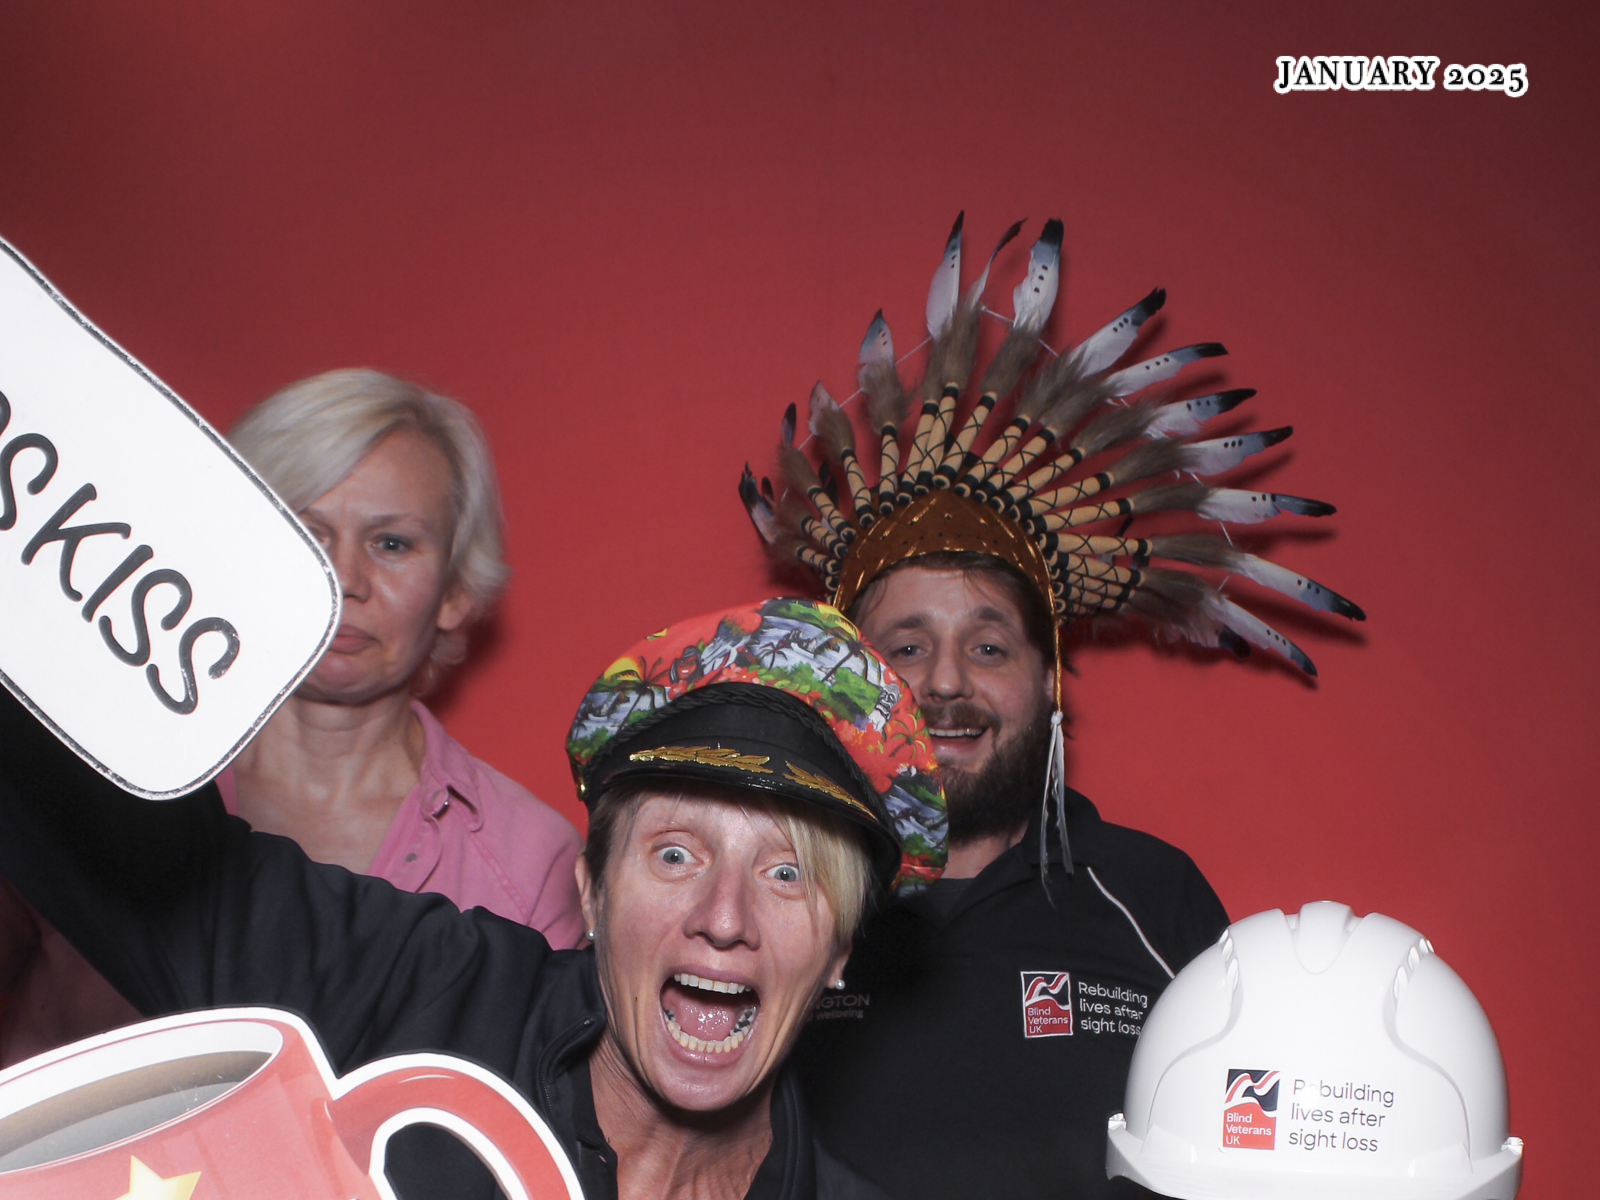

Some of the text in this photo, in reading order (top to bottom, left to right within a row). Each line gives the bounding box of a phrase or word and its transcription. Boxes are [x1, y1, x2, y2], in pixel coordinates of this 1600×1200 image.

[1078, 981, 1148, 1009] Rebuilding
[1027, 1007, 1051, 1016] Blind
[1079, 998, 1144, 1020] lives after
[1027, 1016, 1069, 1025] Veterans
[1080, 1017, 1142, 1036] sight loss
[1029, 1025, 1043, 1034] UK
[1226, 1112, 1252, 1123] Blind
[1290, 1102, 1386, 1128] lives after
[1225, 1124, 1272, 1136] Veterans
[1225, 1135, 1241, 1145] UK
[1288, 1128, 1379, 1152] sight loss
